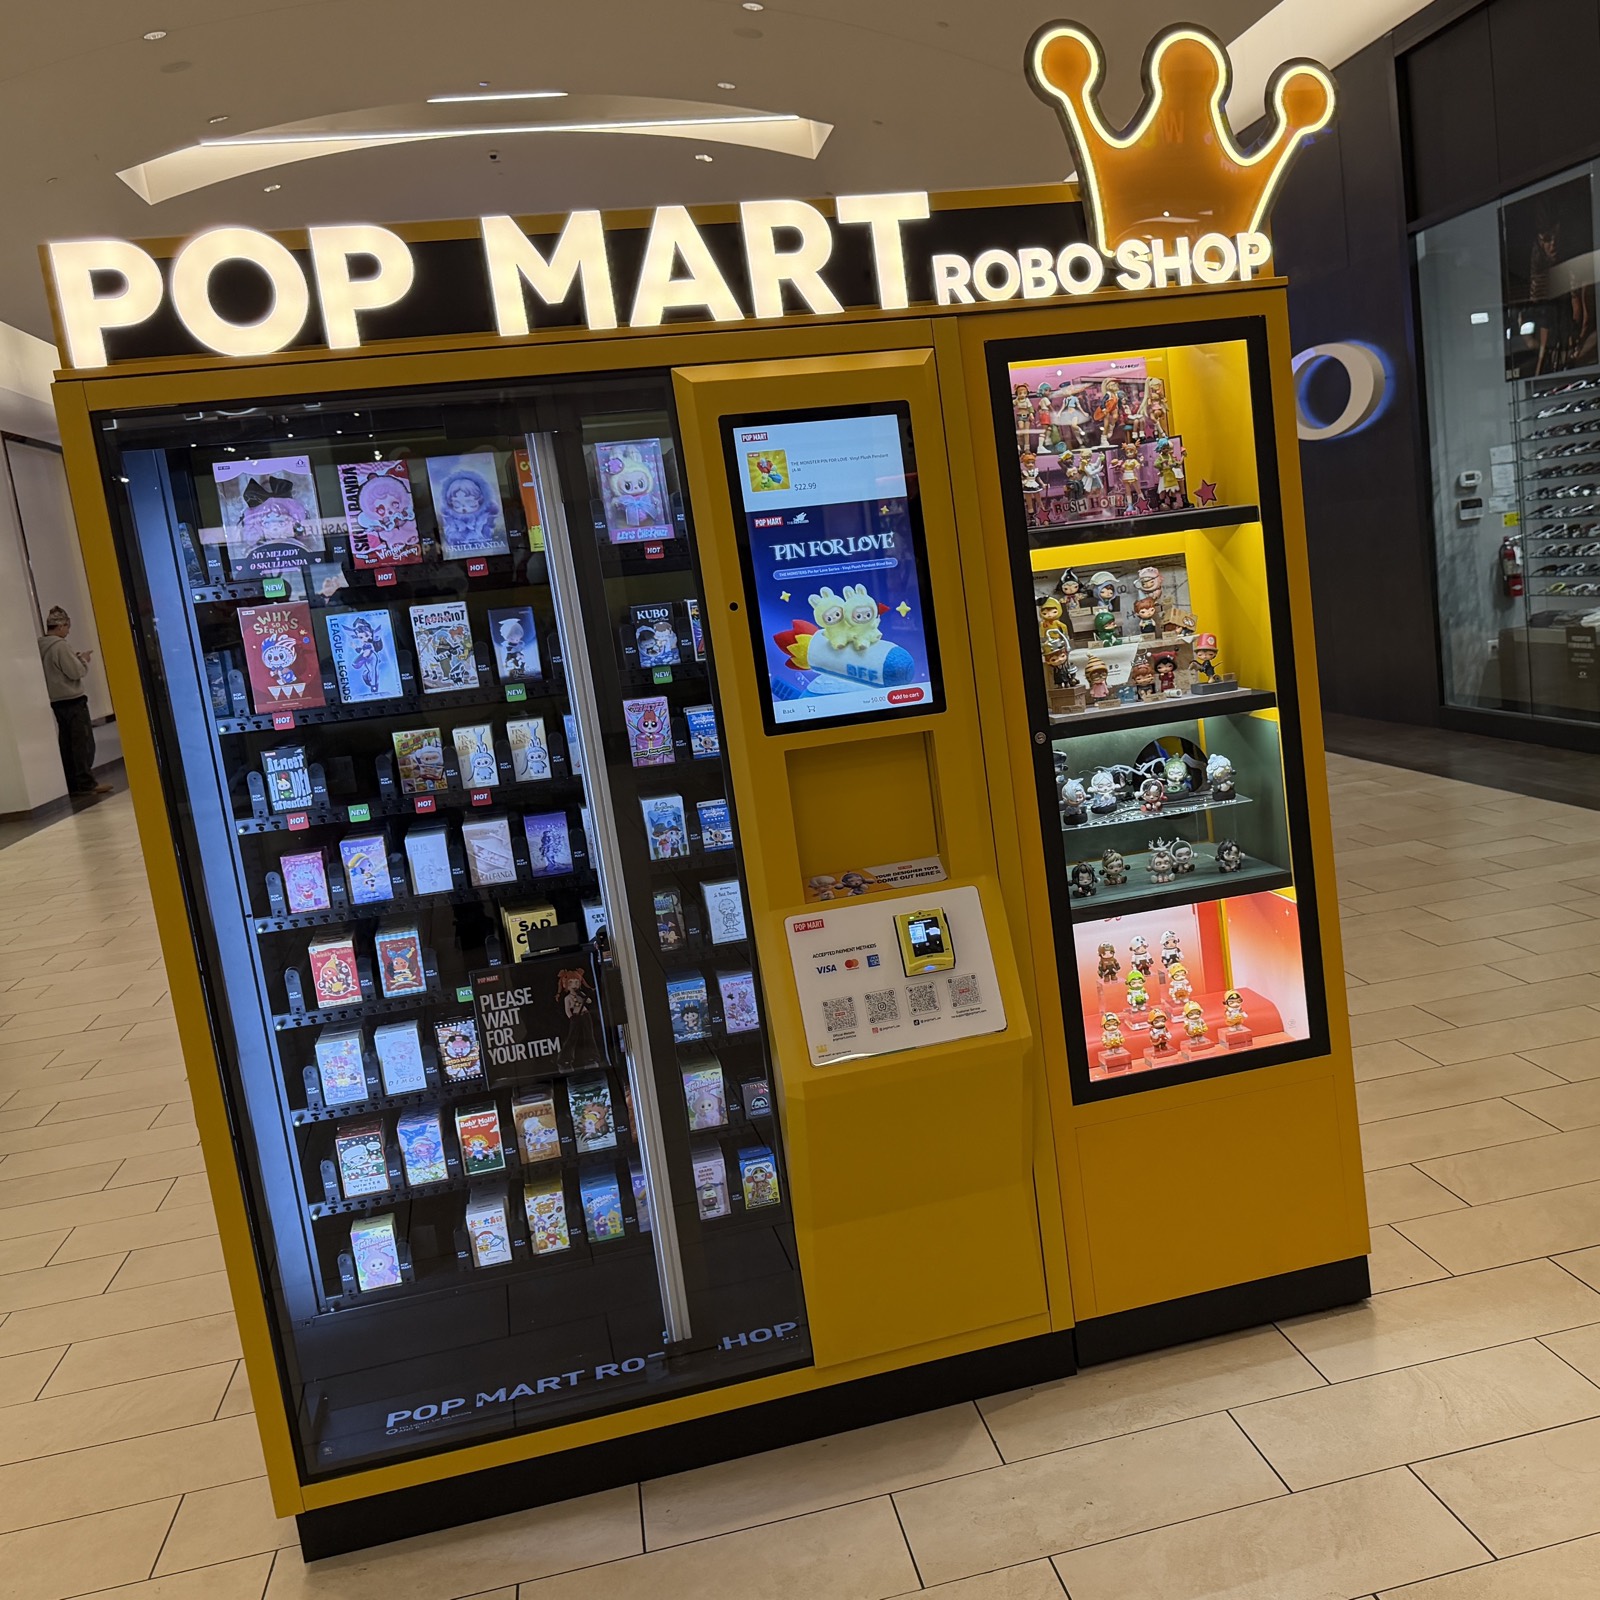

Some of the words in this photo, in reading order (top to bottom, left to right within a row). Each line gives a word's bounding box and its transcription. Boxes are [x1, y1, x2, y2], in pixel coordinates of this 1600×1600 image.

[932, 242, 1102, 305] ROBO
[1116, 231, 1272, 291] SHOP
[48, 226, 415, 369] POP
[480, 191, 930, 337] MART
[1054, 498, 1088, 514] RUSH
[1090, 494, 1126, 510] HOUR
[766, 517, 782, 525] MART
[266, 549, 300, 558] MELODY
[769, 542, 805, 561] PIN
[808, 538, 852, 557] FOR
[847, 531, 895, 552] LOVE
[256, 558, 308, 570] SKULLPANDA
[257, 611, 292, 625] WHY
[636, 608, 669, 620] KUBO
[253, 618, 298, 636] SERIOUS
[330, 618, 344, 654] LEAGUE
[337, 660, 352, 701] LEGENDS
[892, 868, 922, 876] DESIGNER
[519, 920, 550, 932] SAD
[794, 922, 806, 931] POP
[806, 920, 823, 929] MART
[812, 950, 835, 958] ACCEPTED
[836, 946, 855, 955] PAYMENT
[856, 943, 876, 951] METHODS
[816, 964, 837, 975] VISA
[480, 987, 534, 1012] PLEASE
[482, 1008, 520, 1030] WAIT
[486, 1028, 514, 1048] FOR
[488, 1043, 528, 1066] YOUR
[528, 1036, 562, 1058] ITEM
[388, 1076, 422, 1087] DIMOO
[386, 1398, 466, 1428] POP
[476, 1369, 585, 1408] MART
[718, 1322, 797, 1351] HOP
